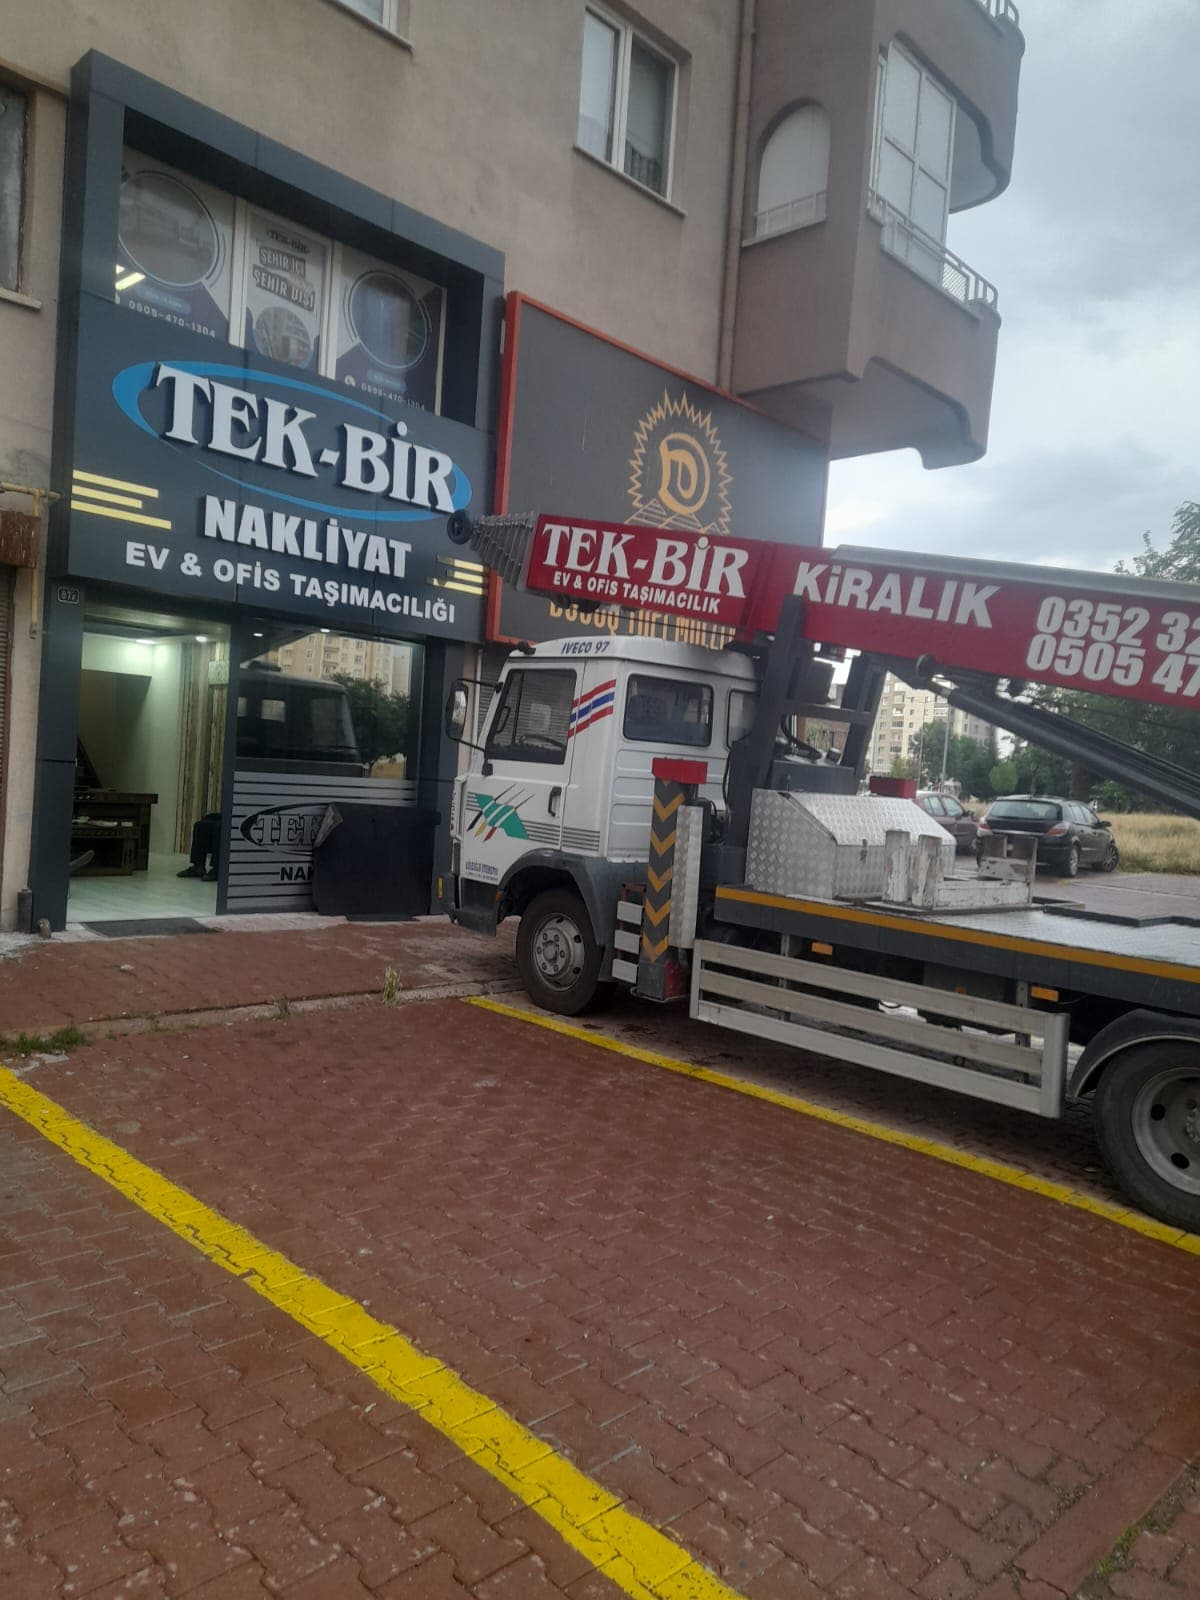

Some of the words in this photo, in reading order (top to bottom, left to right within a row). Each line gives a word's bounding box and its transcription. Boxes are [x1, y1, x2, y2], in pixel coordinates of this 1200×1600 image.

[156, 364, 456, 513] TEK-BİR
[204, 494, 411, 578] NAKLİYAT
[541, 523, 749, 598] TEK-BİR
[125, 541, 170, 570] EV
[180, 552, 202, 577] &
[213, 558, 281, 592] OFİS
[289, 573, 456, 624] TAŞIMACILIĞI
[553, 571, 570, 586] EV
[573, 574, 582, 589] &
[623, 583, 720, 615] TAŞIMACILIK
[793, 561, 1000, 629] KİRALIK
[561, 642, 592, 655] IVECO
[596, 641, 610, 653] 97
[1036, 597, 1150, 647] 0352
[1026, 634, 1146, 687] 0505
[1152, 653, 1200, 697] 47
